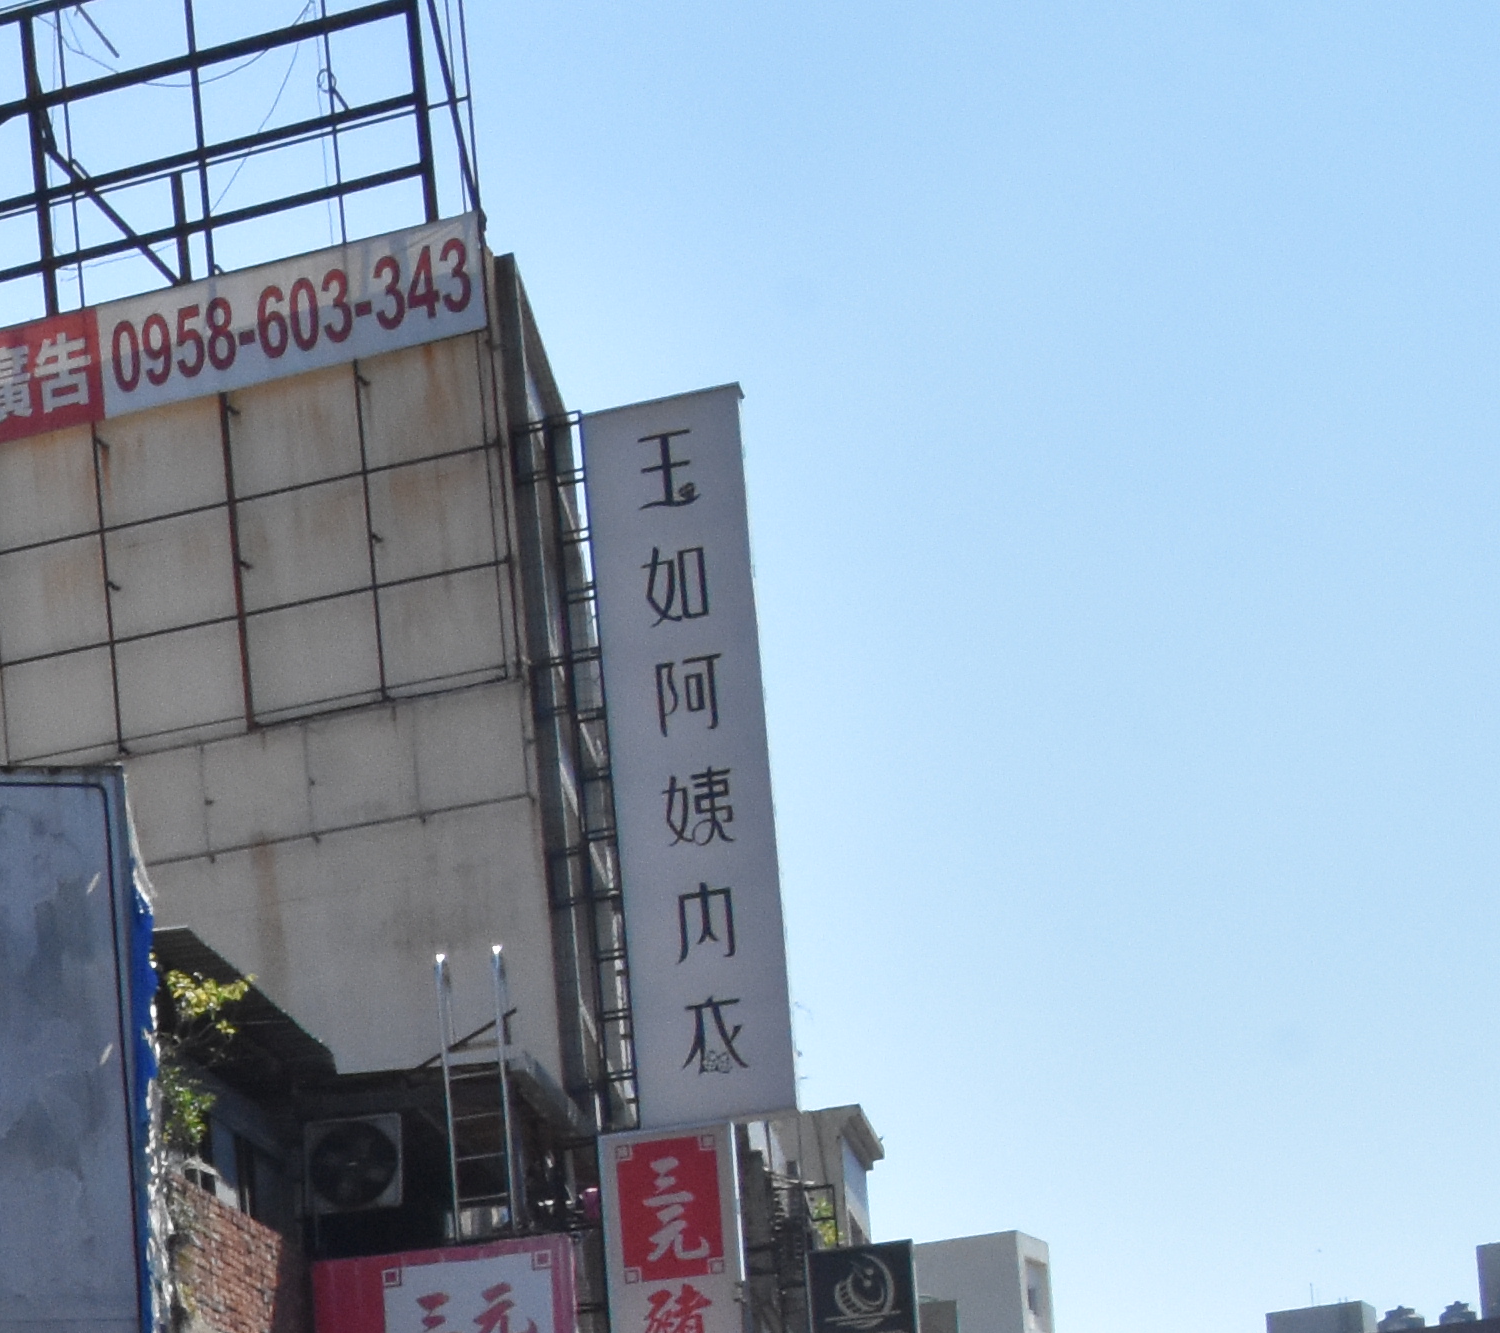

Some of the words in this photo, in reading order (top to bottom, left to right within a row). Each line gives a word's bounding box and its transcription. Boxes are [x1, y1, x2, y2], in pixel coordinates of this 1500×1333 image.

[112, 239, 471, 392] 0958-603-343
[637, 426, 748, 1075] 玉如阿姨內衣
[643, 1156, 710, 1265] 三元
